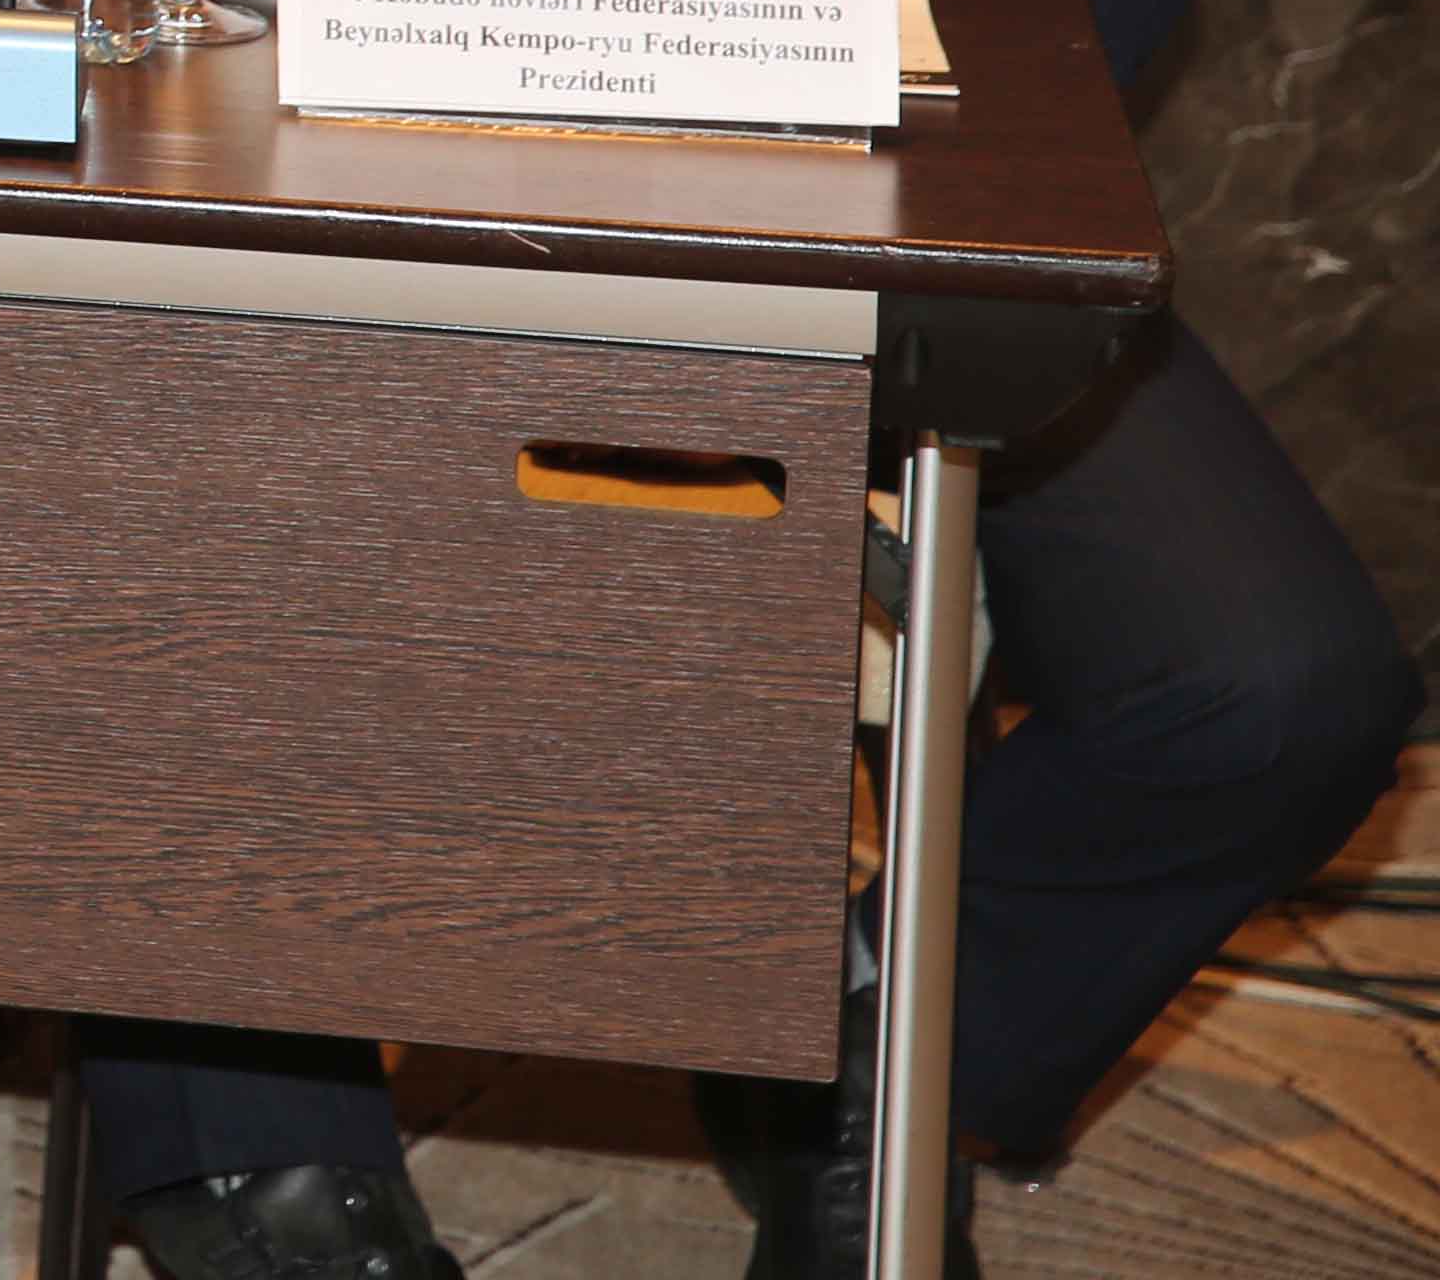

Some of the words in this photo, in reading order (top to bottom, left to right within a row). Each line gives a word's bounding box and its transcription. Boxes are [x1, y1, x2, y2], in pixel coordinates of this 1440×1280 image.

[814, 4, 842, 22] və
[324, 18, 469, 51] Beynəlxalq
[481, 26, 632, 58] Kempo-ryu
[643, 32, 854, 64] Federasiyasının
[520, 67, 655, 94] Prezidenti
